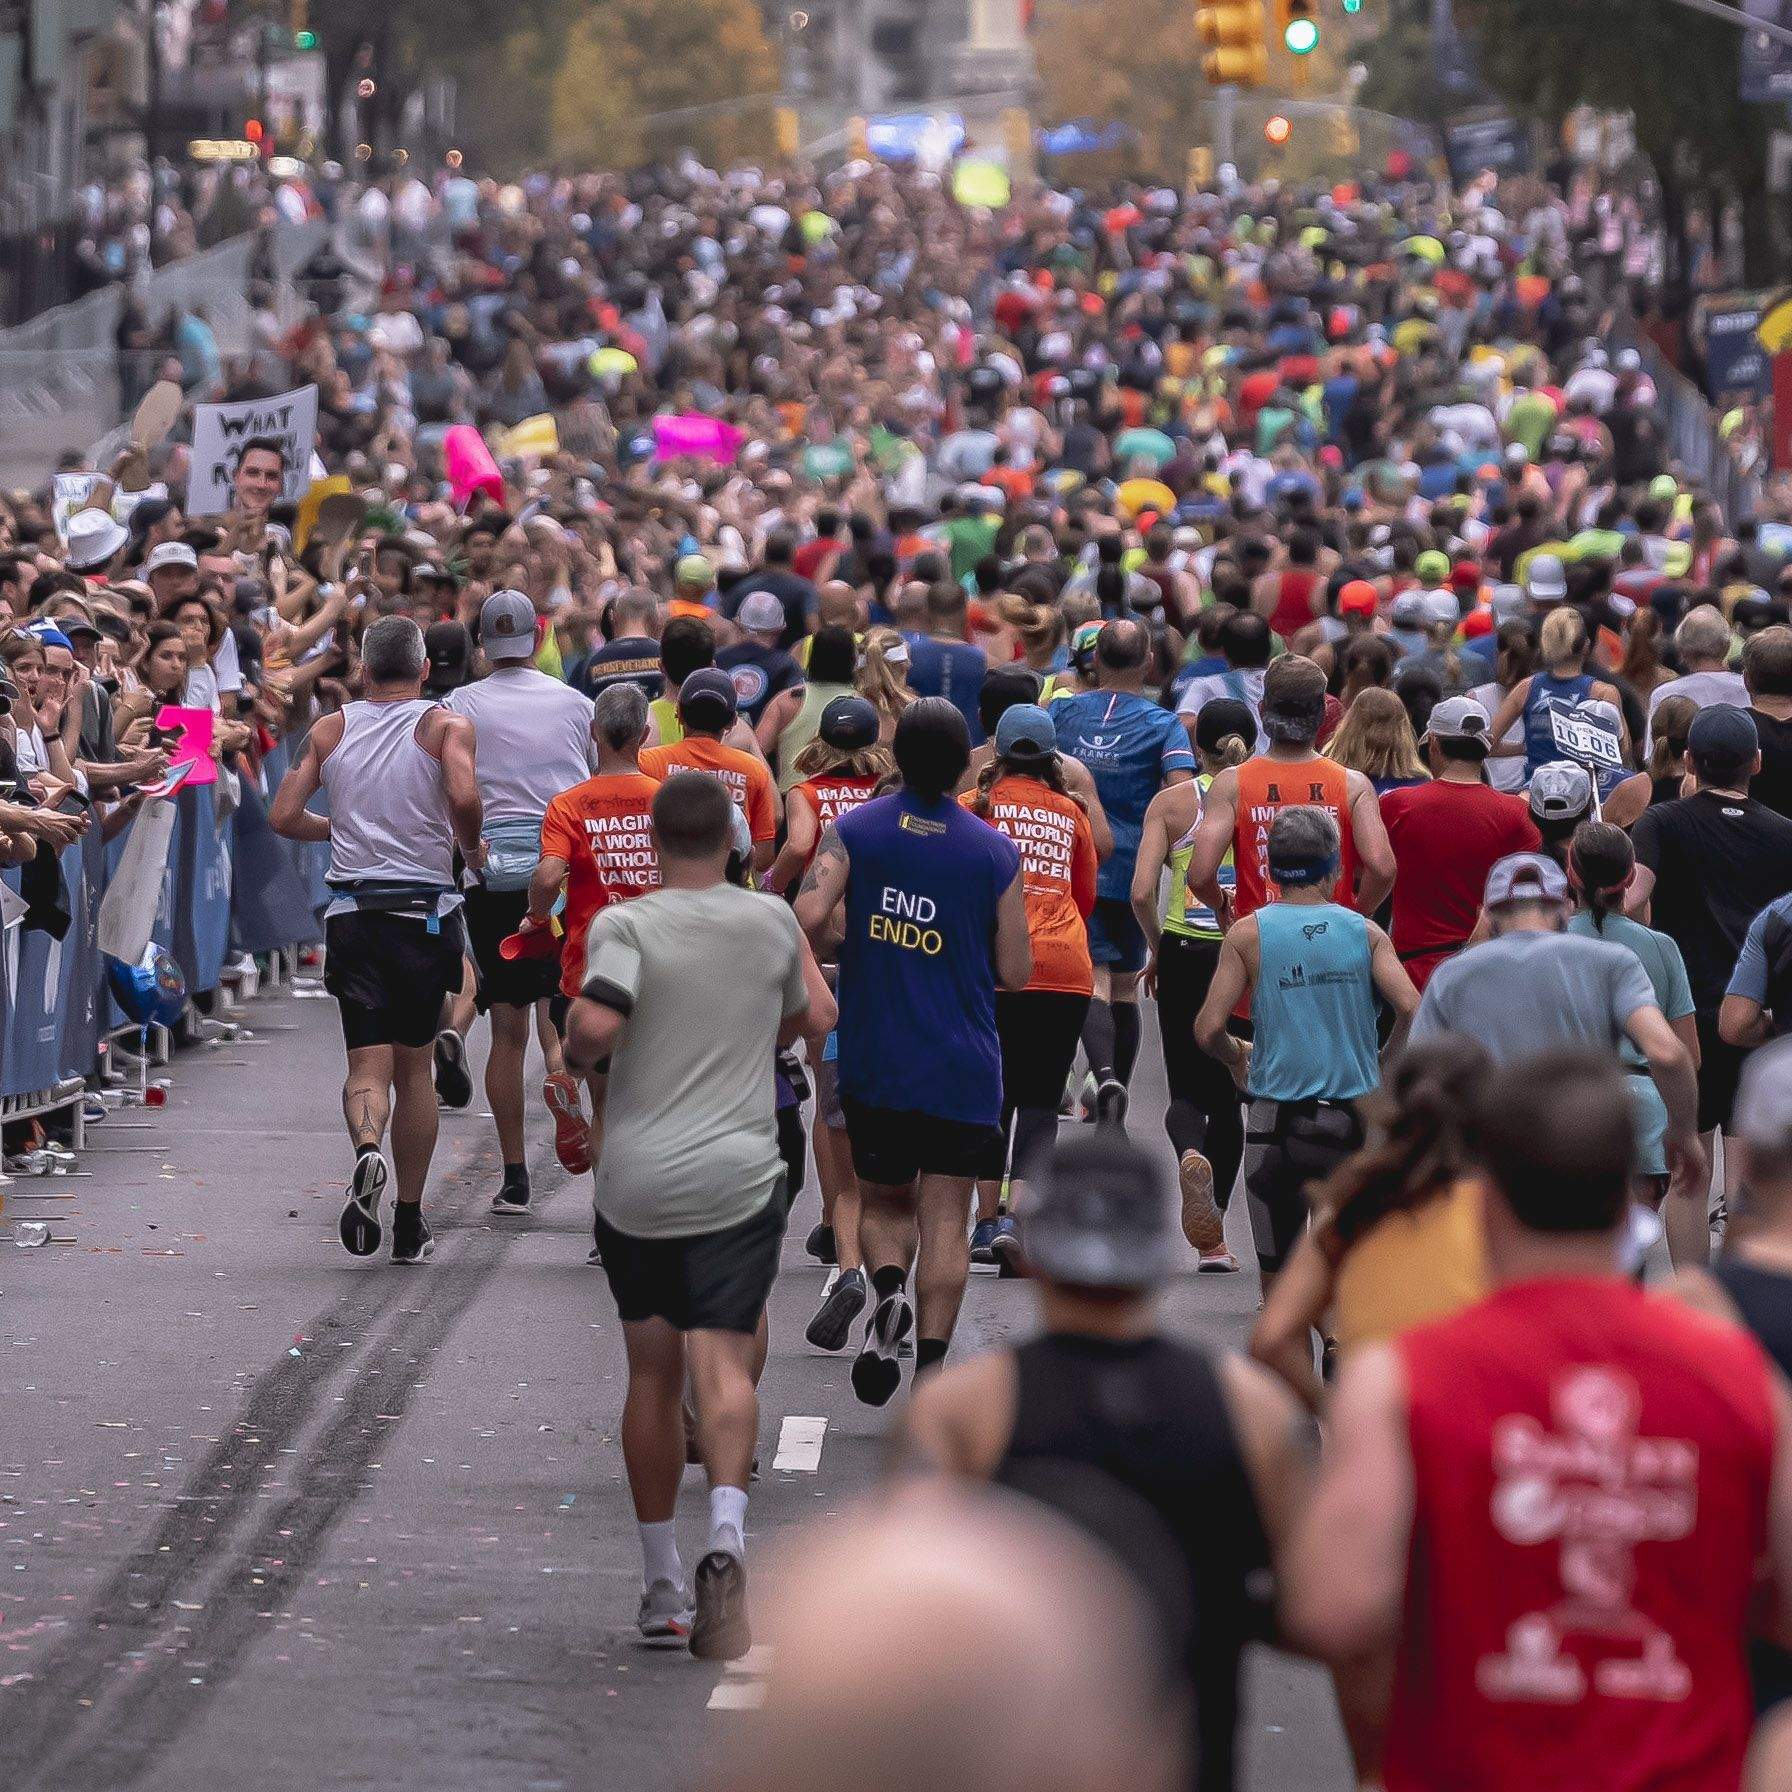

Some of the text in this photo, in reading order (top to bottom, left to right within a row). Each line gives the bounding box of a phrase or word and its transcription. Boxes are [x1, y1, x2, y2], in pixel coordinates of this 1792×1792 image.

[218, 405, 294, 439] WHAT
[1556, 724, 1618, 759] 10:06
[820, 802, 834, 817] A
[994, 804, 1075, 834] IMAGINE
[996, 821, 1011, 836] A
[591, 835, 603, 852] A
[595, 851, 660, 869] WITHOU
[1022, 857, 1072, 882] NCER
[600, 869, 662, 886] CANCE
[882, 886, 936, 923] END
[869, 914, 943, 955] ENDO
